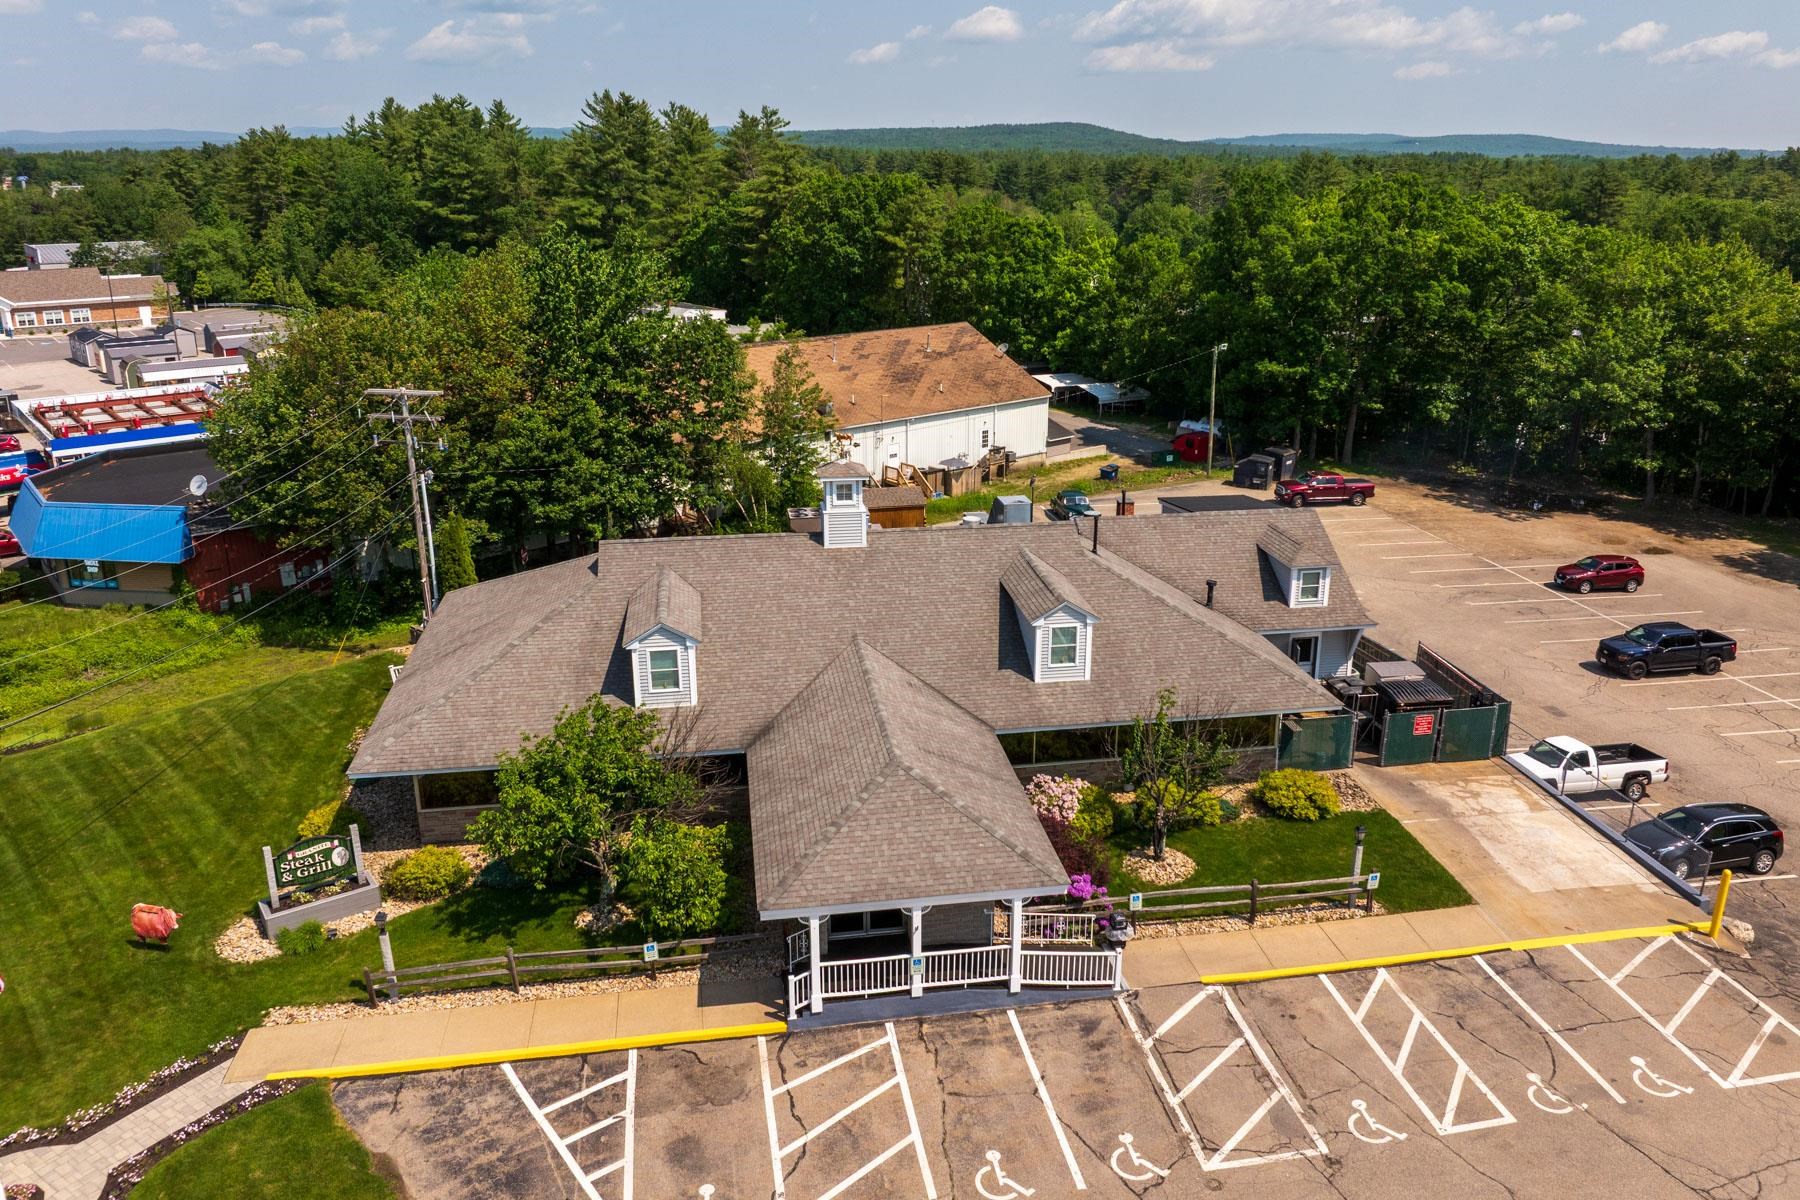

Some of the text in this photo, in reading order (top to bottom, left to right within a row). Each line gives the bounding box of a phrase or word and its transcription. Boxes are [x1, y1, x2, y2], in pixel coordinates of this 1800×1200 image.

[280, 853, 325, 872] Steak
[282, 860, 333, 882] & Grill
